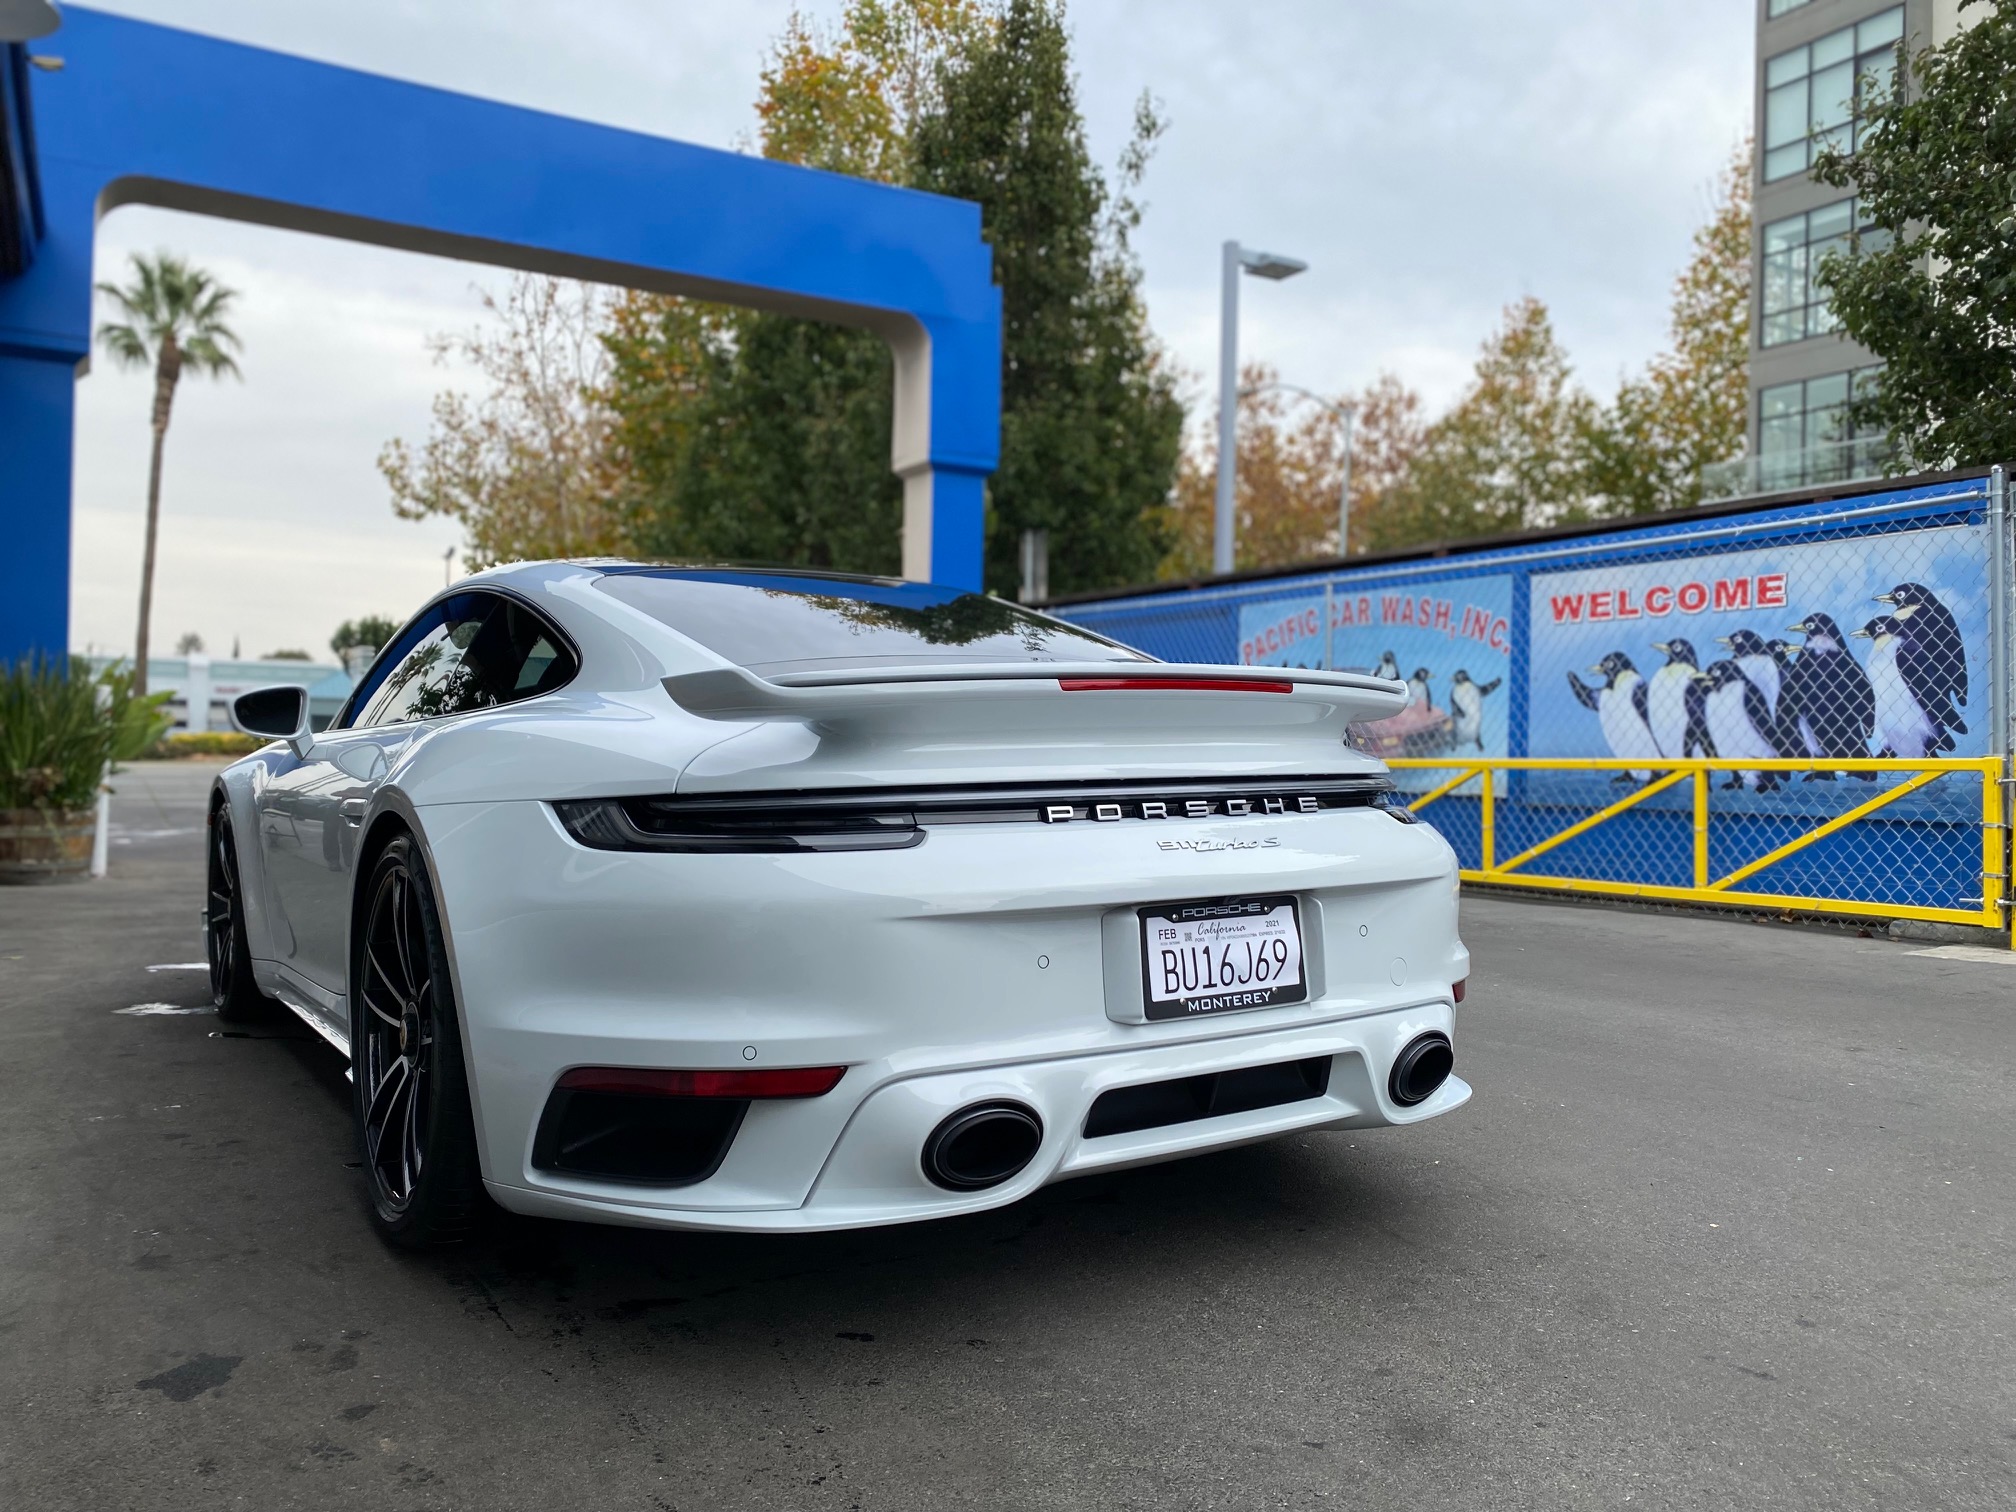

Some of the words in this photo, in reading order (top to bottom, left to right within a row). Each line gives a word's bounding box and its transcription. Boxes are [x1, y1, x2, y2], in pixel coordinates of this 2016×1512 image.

[1551, 573, 1786, 622] WELCOME
[1241, 607, 1319, 665] PACIFIC
[1381, 596, 1456, 640] WASH,
[1461, 605, 1511, 655] INC.
[1046, 797, 1319, 823] PORSCHE
[1182, 903, 1262, 918] PORSCHE
[1158, 928, 1177, 940] FEB
[1197, 921, 1247, 941] California
[1264, 919, 1280, 928] 2021
[1161, 938, 1288, 994] BU16J69
[1188, 990, 1271, 1012] MONTEREY
